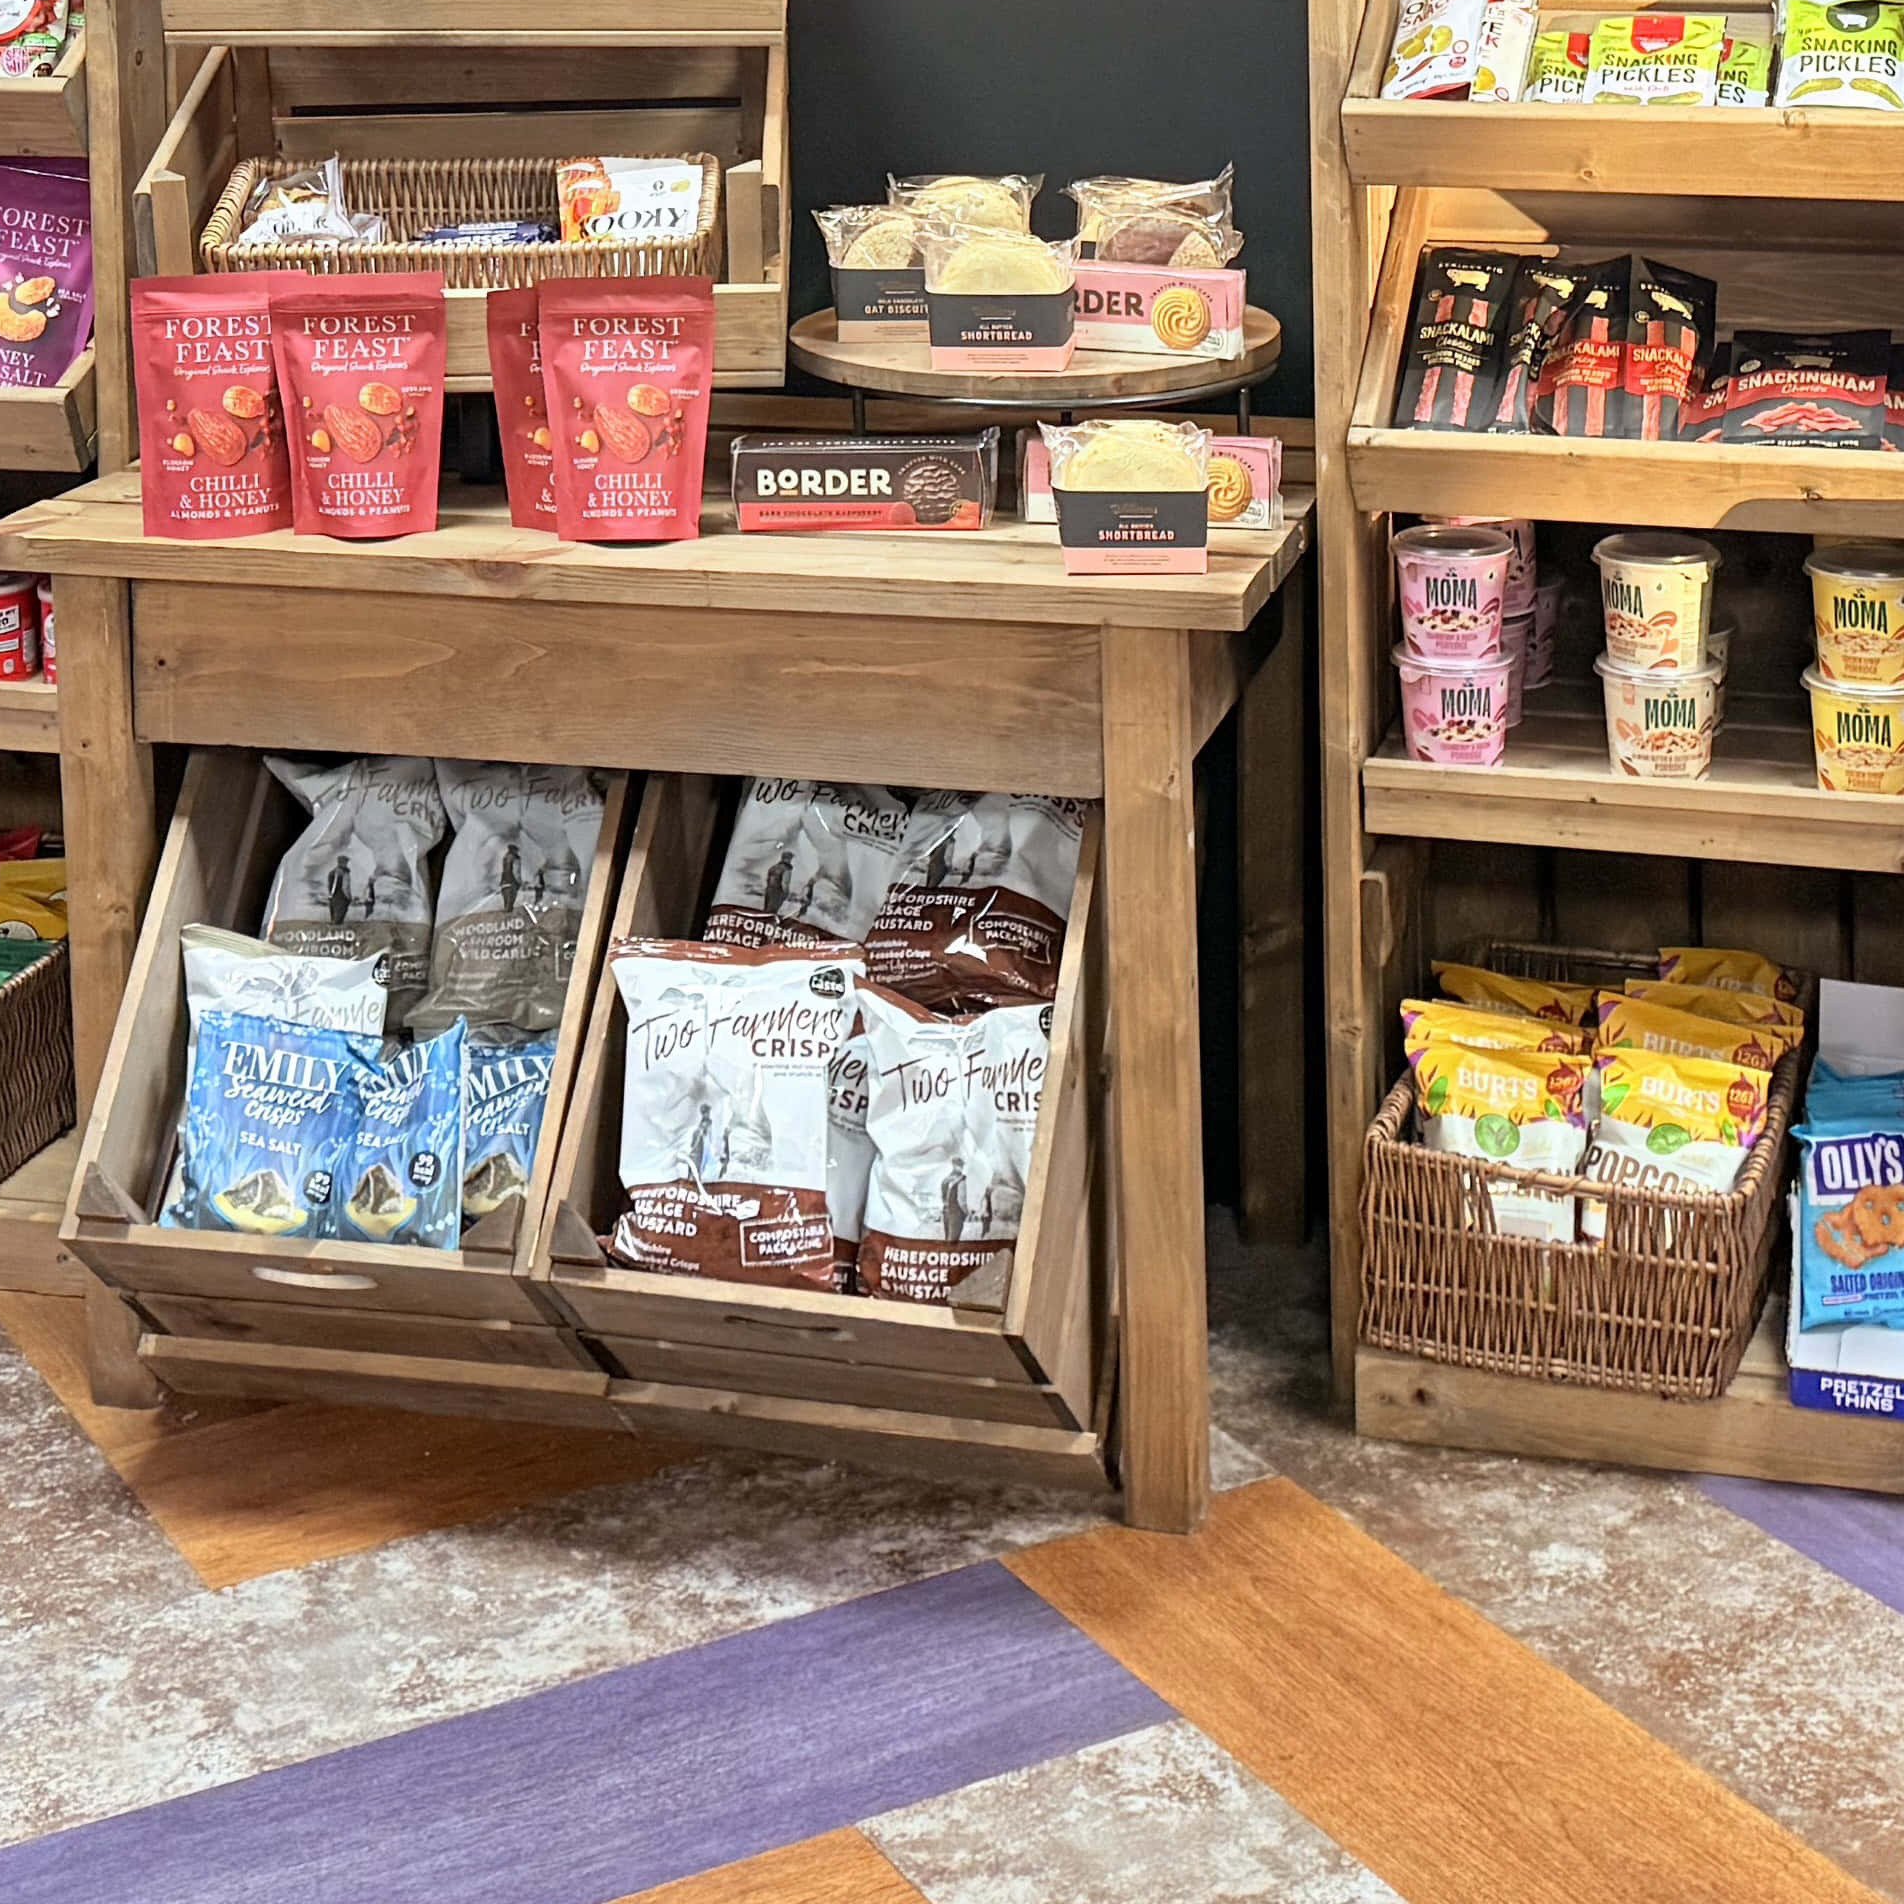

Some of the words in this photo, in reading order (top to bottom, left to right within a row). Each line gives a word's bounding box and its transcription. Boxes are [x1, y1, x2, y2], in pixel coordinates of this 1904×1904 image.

[1801, 36, 1897, 57] SNACKING
[1604, 54, 1698, 67] SNACKING
[1800, 55, 1897, 77] PICKLES
[1602, 68, 1696, 85] PICKLES
[303, 314, 417, 336] FOREST
[572, 317, 686, 336] FOREST
[960, 330, 1033, 342] SHORTBREAD
[1419, 322, 1495, 346] SNACKALAMI
[176, 341, 268, 364] FEAST
[313, 337, 408, 360] FEAST
[583, 340, 676, 361] FEAST
[1633, 348, 1693, 371] SNACKALA
[0, 366, 47, 386] SALT
[1738, 371, 1876, 393] SNACKINGHAM
[190, 473, 260, 492] CHILLI
[327, 471, 394, 489] CHILLI
[594, 473, 663, 490] CHILLI
[756, 468, 893, 497] BORDER
[180, 494, 193, 509] &
[199, 487, 272, 509] HONEY
[322, 492, 332, 505] &
[335, 488, 405, 506] HONEY
[587, 492, 598, 508] &
[602, 490, 673, 508] HONEY
[170, 509, 221, 519] ALMONDS
[1098, 530, 1175, 541] SHORTBREAD
[1425, 576, 1478, 610] MOMA
[1833, 596, 1888, 634] MOMA
[1440, 687, 1491, 720] MOMA
[1645, 698, 1696, 731] MOMA
[1836, 711, 1891, 748] MOMA
[632, 1008, 704, 1072] Two
[707, 999, 844, 1049] Farmers
[220, 1040, 353, 1096] EMILY
[467, 1056, 557, 1108] MILY
[882, 1055, 957, 1114] Two
[1457, 1067, 1538, 1098] BURTS
[225, 1073, 334, 1115] Seaweed
[1640, 1076, 1721, 1114] BURTS
[244, 1097, 306, 1130] Crisps
[239, 1132, 266, 1148] SEA
[268, 1138, 302, 1156] SALT
[356, 1132, 380, 1147] SEA
[417, 1153, 434, 1166] 99
[1820, 1138, 1904, 1189] OLLY'S
[880, 1263, 948, 1284] SAUSAGE
[1830, 1272, 1867, 1294] SALTED
[1832, 1391, 1896, 1413] THINS
